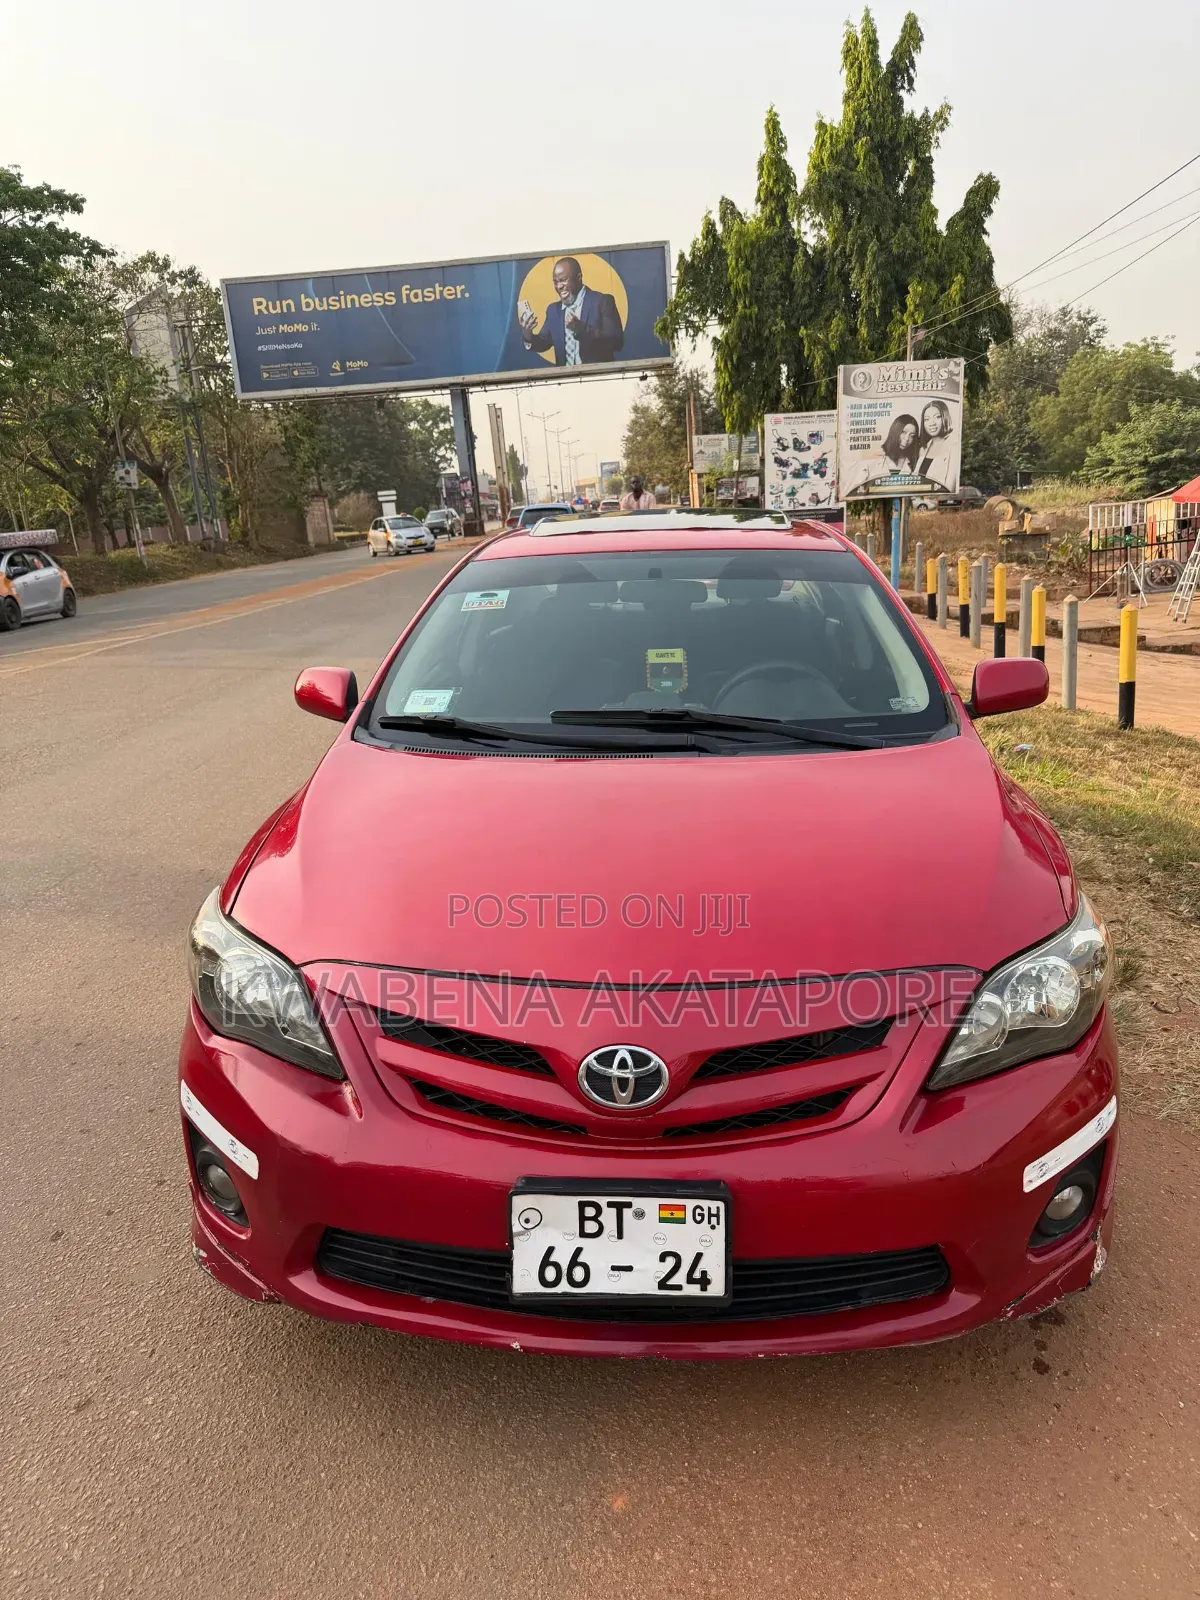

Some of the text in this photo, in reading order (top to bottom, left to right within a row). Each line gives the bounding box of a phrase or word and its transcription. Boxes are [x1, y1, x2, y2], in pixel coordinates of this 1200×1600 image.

[252, 282, 470, 316] Run business faster.
[255, 322, 320, 335] Just MoMo it.
[346, 360, 369, 368] MoMo
[877, 364, 950, 382] Mimi's
[876, 379, 946, 393] Best Hair
[863, 410, 891, 418] PRODUCTS
[849, 419, 877, 427] JEWELRIES
[849, 427, 876, 435] PERFUMES
[849, 435, 871, 443] PANTIES
[577, 1200, 721, 1240] BT GH
[537, 1245, 712, 1292] 66 - 24
